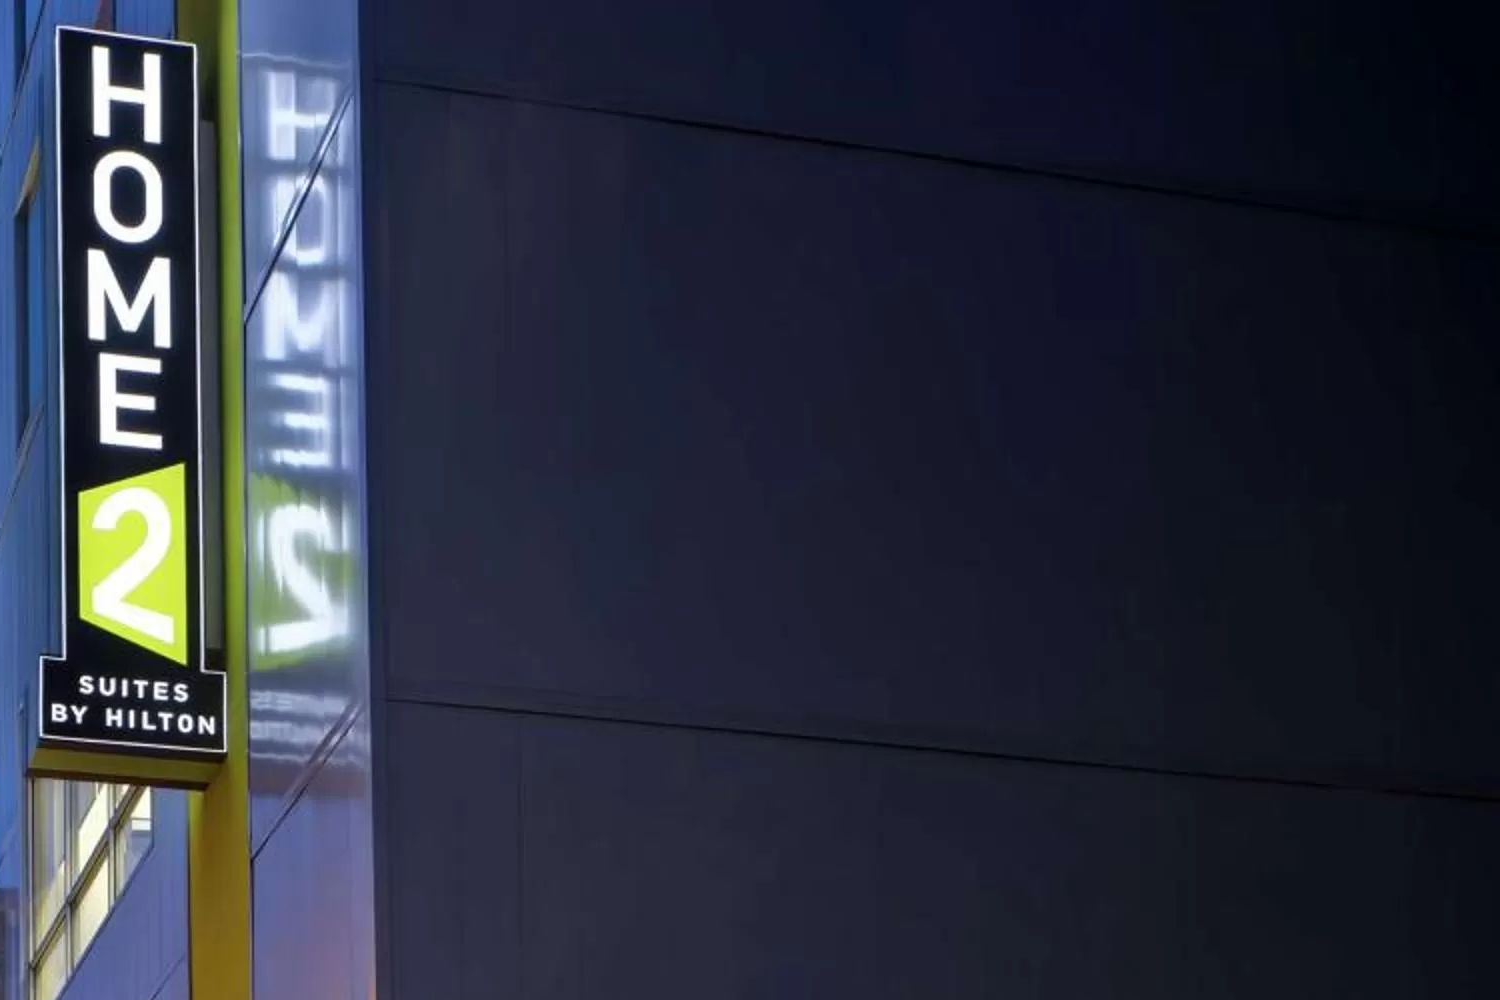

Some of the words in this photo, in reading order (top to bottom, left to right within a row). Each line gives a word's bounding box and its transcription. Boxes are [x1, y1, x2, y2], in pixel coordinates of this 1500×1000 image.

[87, 45, 173, 450] HOME
[91, 486, 175, 645] 2
[51, 703, 88, 724] BY
[105, 707, 216, 736] HILTON
[79, 675, 190, 702] SUITES
